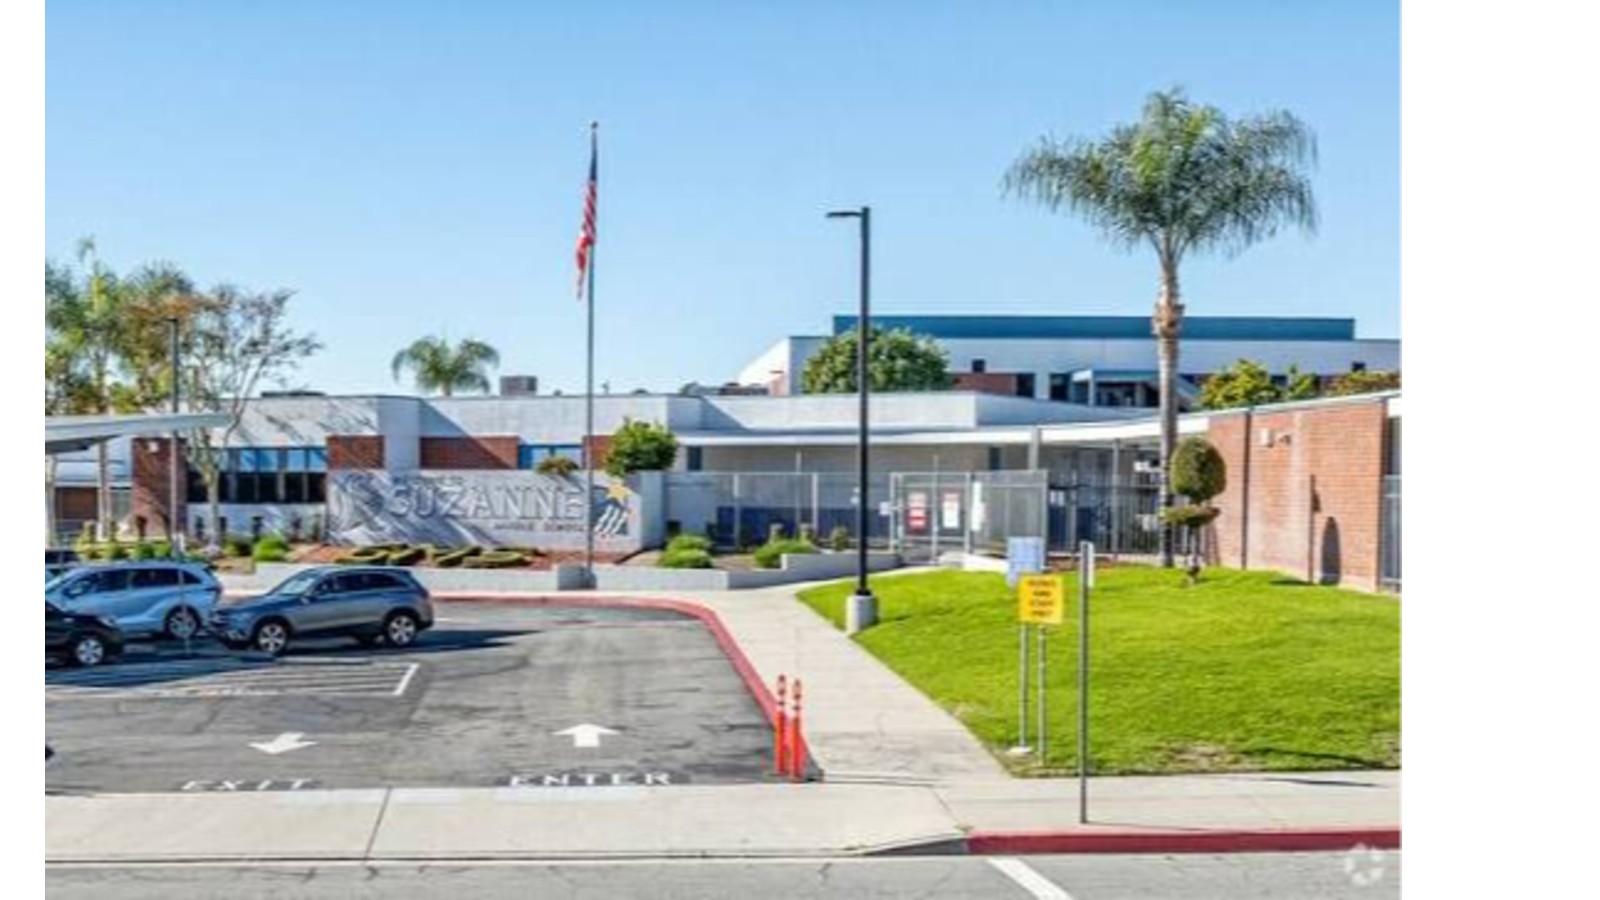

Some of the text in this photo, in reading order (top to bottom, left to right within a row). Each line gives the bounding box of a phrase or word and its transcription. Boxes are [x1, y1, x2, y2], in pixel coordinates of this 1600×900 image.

[388, 483, 586, 520] SUZANNE
[182, 779, 313, 791] EXIT
[510, 773, 671, 786] ENTER
